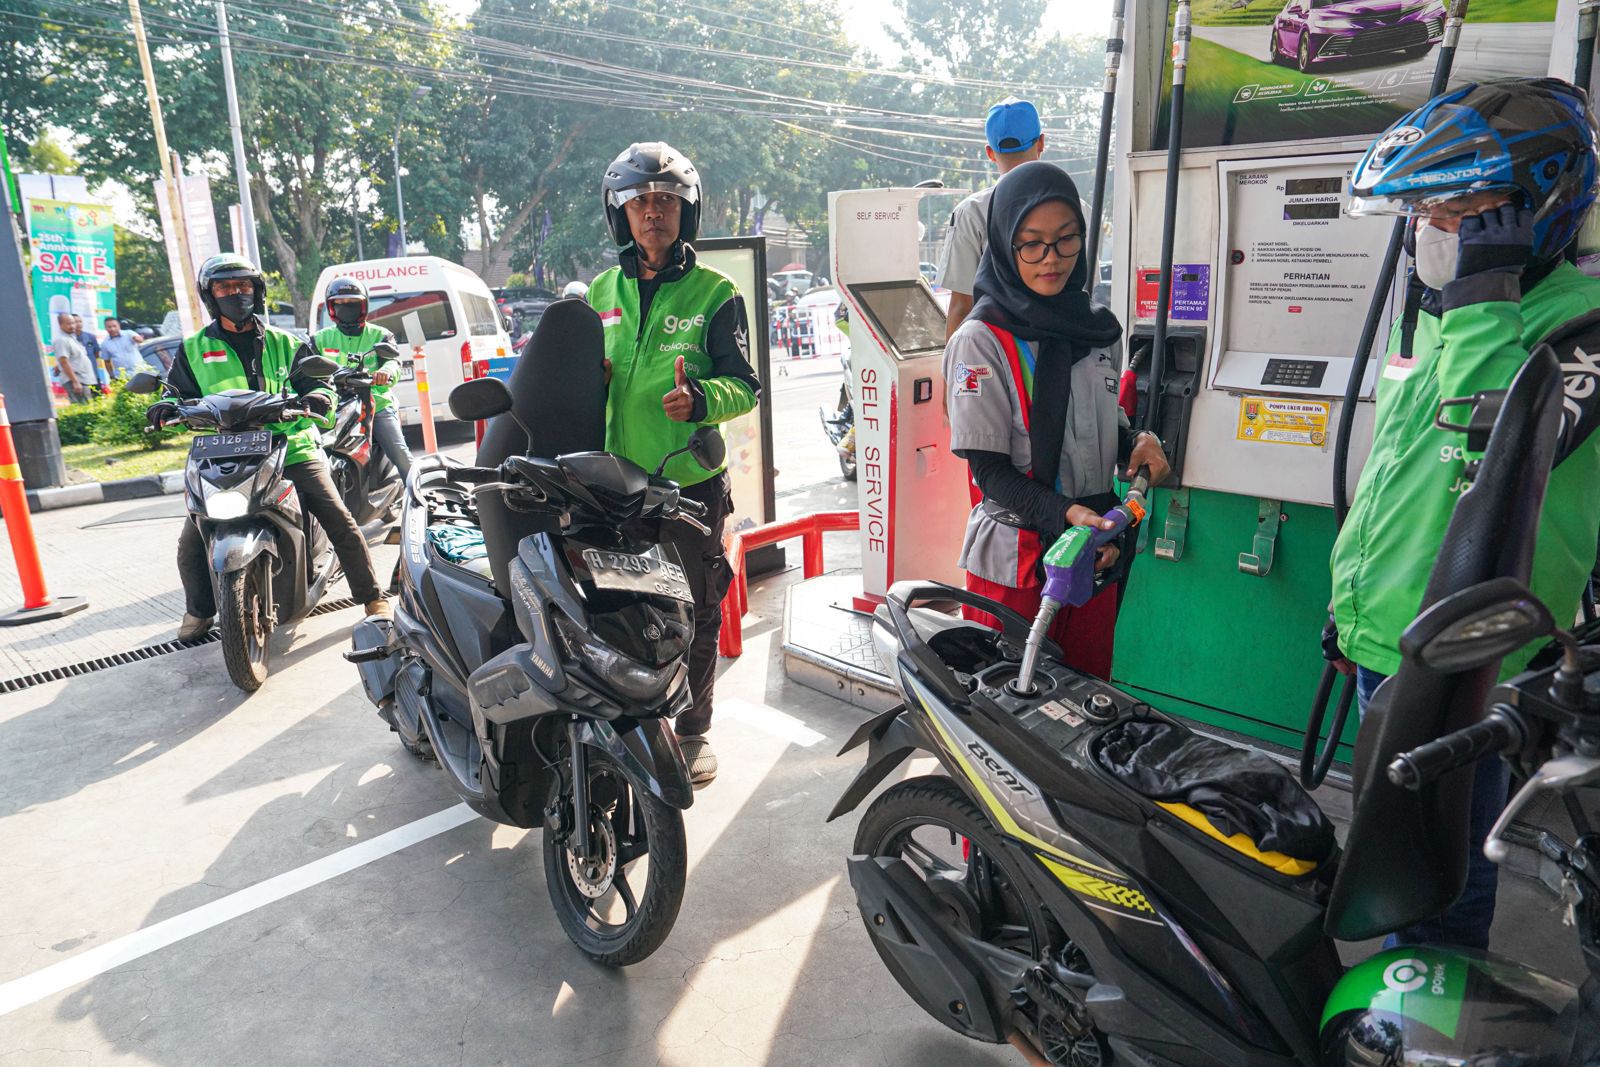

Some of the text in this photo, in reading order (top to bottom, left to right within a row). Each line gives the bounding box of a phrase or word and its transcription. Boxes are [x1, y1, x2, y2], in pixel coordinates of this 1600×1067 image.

[1408, 167, 1482, 186] PREDATOR
[857, 211, 900, 220] SELF SERVICE
[40, 253, 106, 275] SALE
[334, 265, 429, 282] BULANCE
[1284, 272, 1330, 280] PERHATIAN
[663, 314, 707, 334] goje
[196, 432, 267, 447] H 5126 HS
[861, 368, 884, 554] SELF SERVICE
[590, 552, 604, 569] H
[608, 554, 651, 574] 2293
[530, 652, 556, 679] YAMAHA
[1432, 962, 1447, 995] gojek
